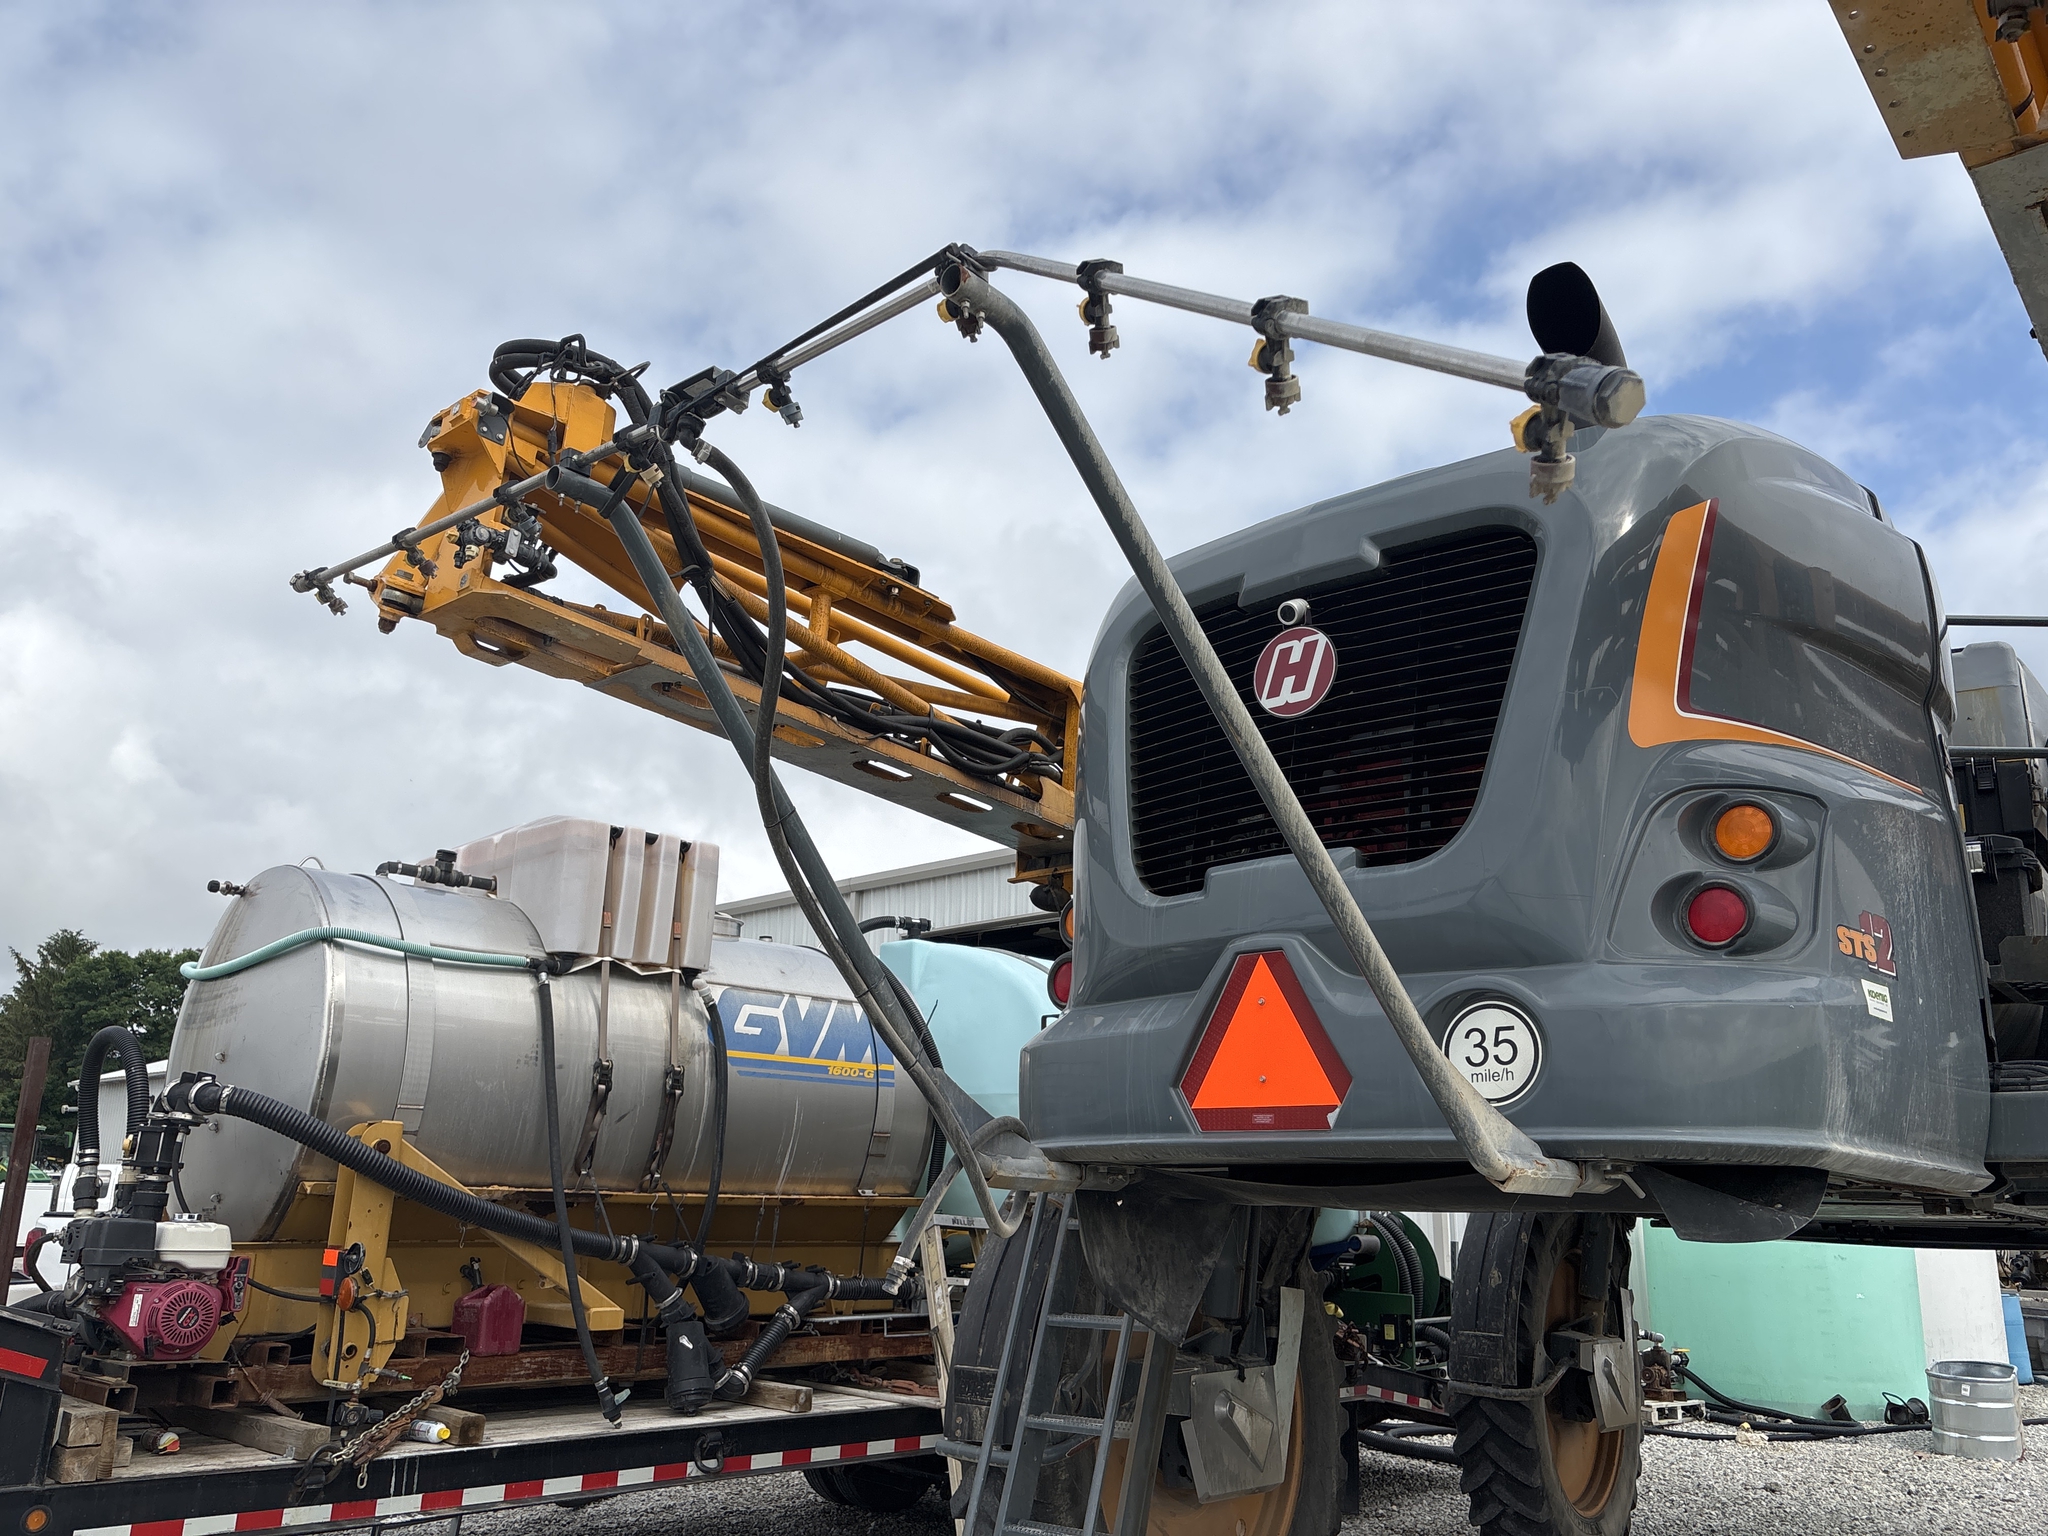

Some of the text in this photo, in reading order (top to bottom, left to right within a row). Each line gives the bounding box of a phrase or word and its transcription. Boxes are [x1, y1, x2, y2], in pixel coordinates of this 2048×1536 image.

[1836, 925, 1878, 963] STS
[709, 988, 894, 1064] GVM
[1464, 1025, 1519, 1067] 35
[827, 1065, 876, 1079] 1600-G
[1470, 1068, 1515, 1083] mile/h
